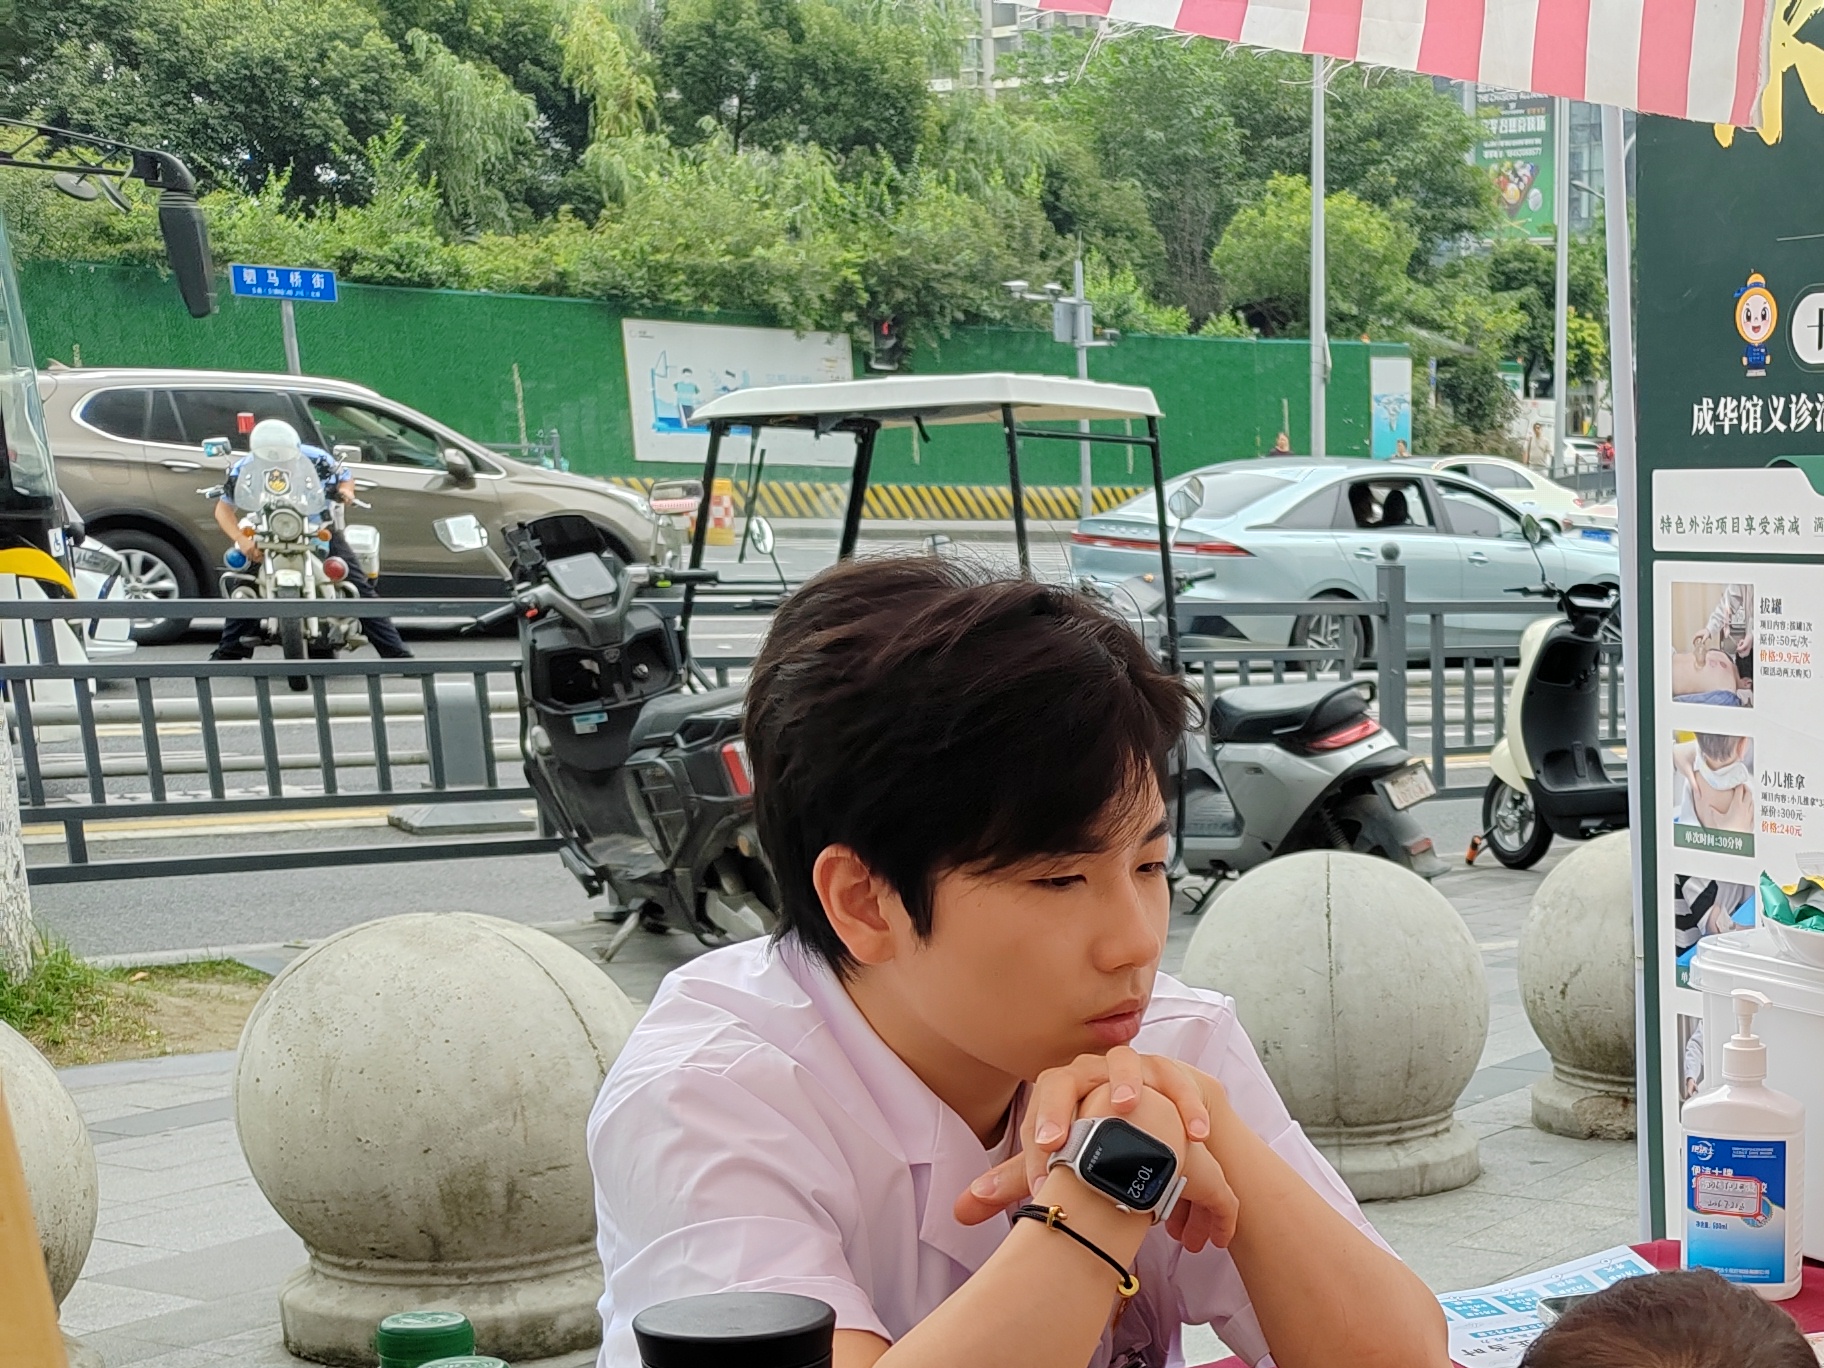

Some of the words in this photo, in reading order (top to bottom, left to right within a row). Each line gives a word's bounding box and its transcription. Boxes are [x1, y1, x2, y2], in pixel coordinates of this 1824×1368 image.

[1659, 514, 1801, 537] 特色外治项目享受满减
[1760, 597, 1783, 616] 拔罐
[1760, 770, 1806, 790] 小儿推拿
[1127, 1165, 1153, 1199] 10:32
